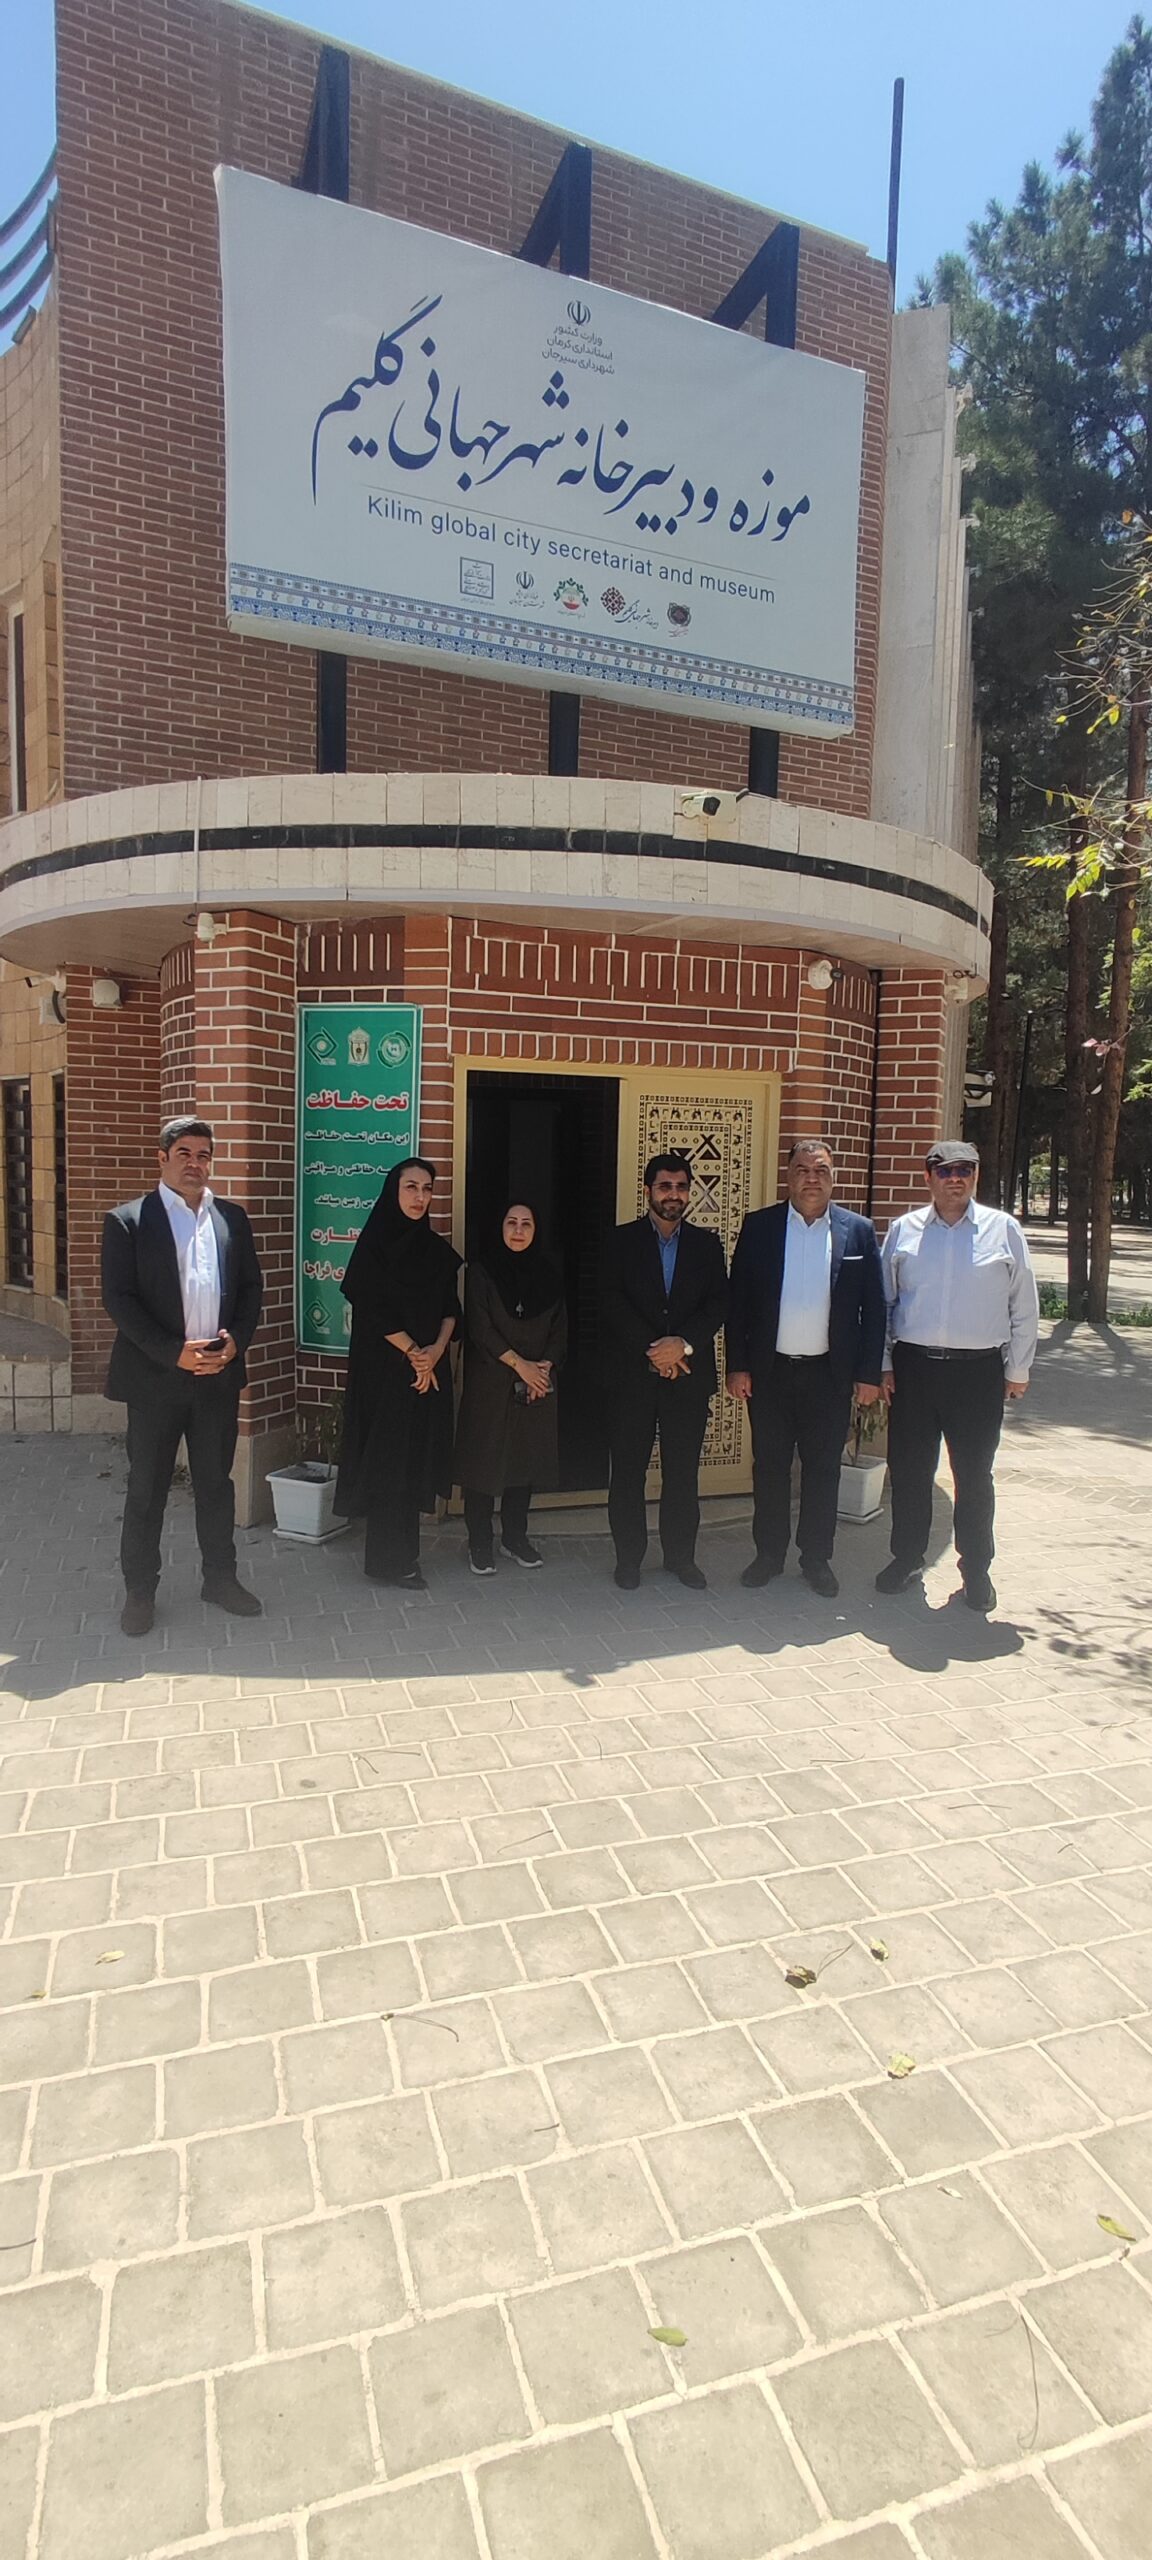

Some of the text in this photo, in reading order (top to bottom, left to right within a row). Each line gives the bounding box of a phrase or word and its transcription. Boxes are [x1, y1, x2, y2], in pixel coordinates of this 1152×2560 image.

[547, 335, 613, 360] استانداری کرمان
[553, 326, 603, 347] وزارت کشور
[542, 348, 615, 375] شهرداری سیرجان
[312, 294, 443, 506] گلیم
[388, 336, 511, 492] جهانی
[475, 370, 570, 486] شهر
[729, 468, 810, 542] موزه
[368, 495, 775, 604] Kilim global city secretariat and museum
[307, 1089, 409, 1111] تحت حفاظت
[305, 1130, 409, 1145] این مکان تحت حفاظت
[338, 1166, 344, 1176] و
[345, 1163, 375, 1176] حفاظتی
[303, 1260, 332, 1280] فراجا
